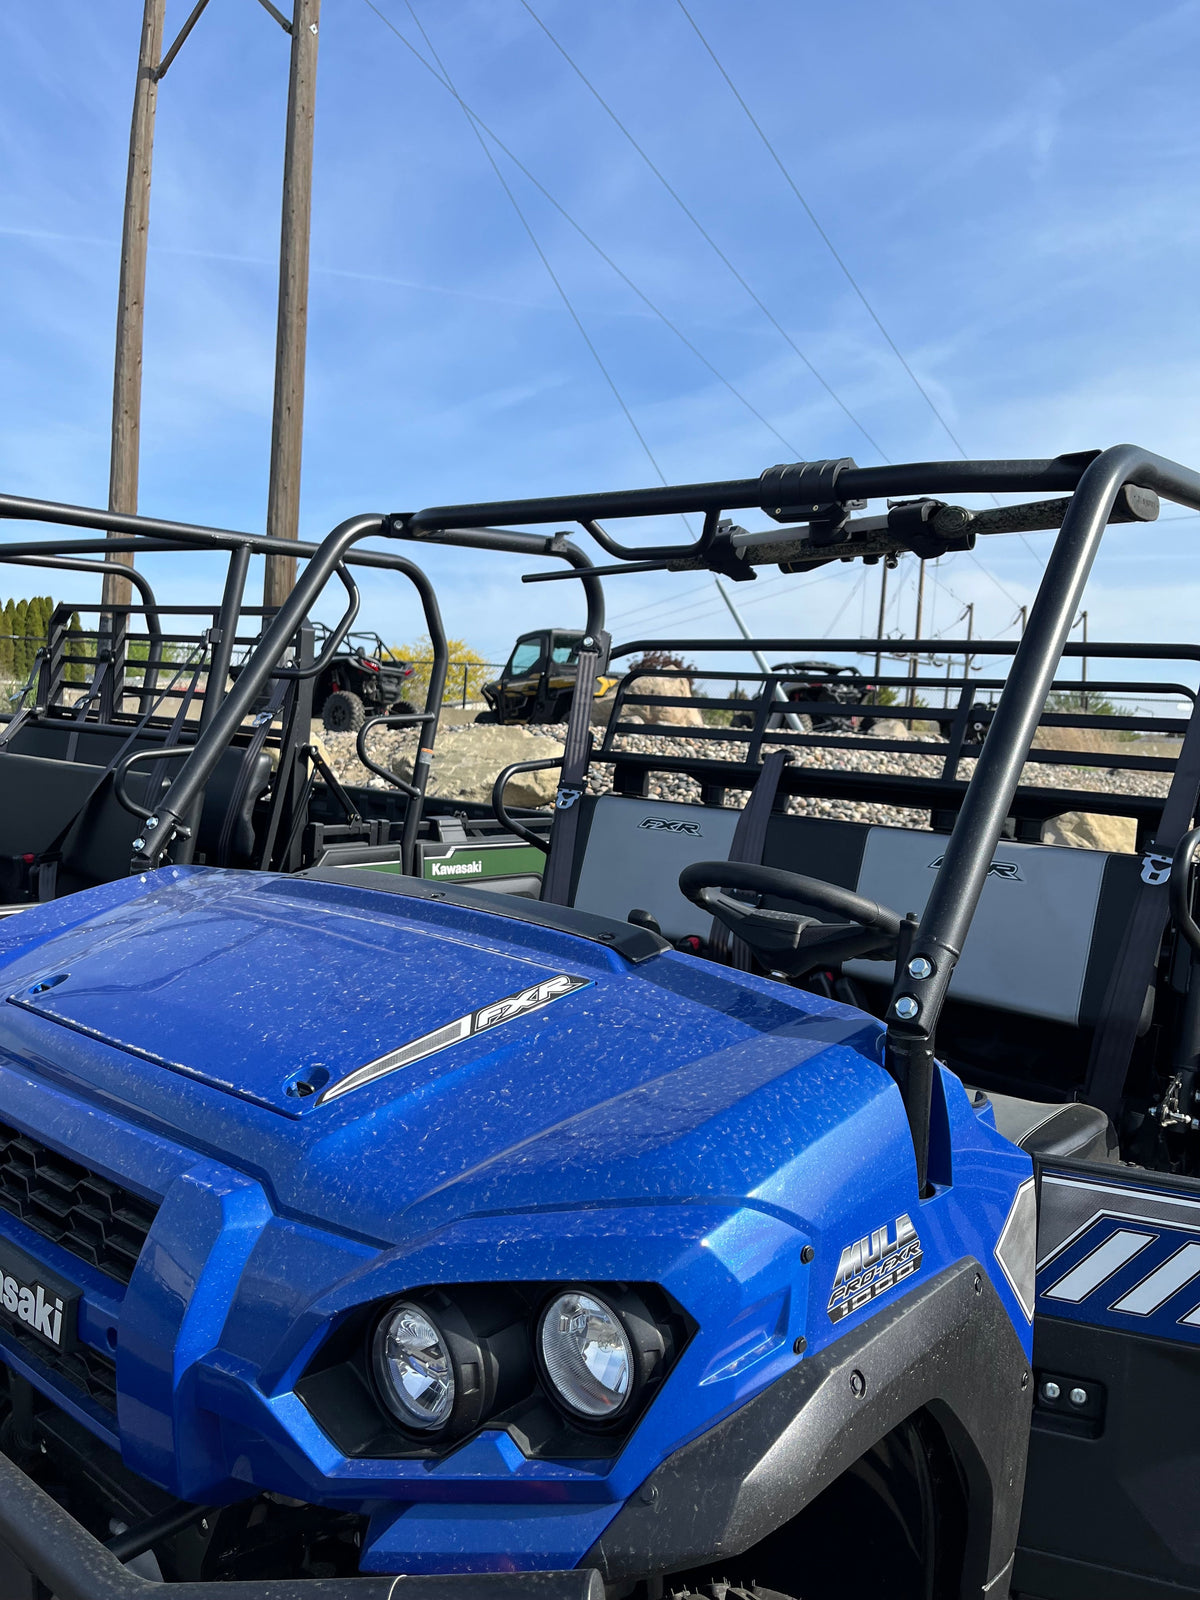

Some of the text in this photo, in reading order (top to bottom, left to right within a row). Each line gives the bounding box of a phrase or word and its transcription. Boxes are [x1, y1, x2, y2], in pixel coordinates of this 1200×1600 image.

[638, 817, 703, 837] FXR
[432, 861, 482, 876] Kawasaki
[475, 975, 583, 1032] FXR
[827, 1240, 923, 1310] PRO-FXR
[832, 1213, 919, 1290] MULE
[0, 1270, 64, 1345] saki
[840, 1261, 915, 1316] 1000
